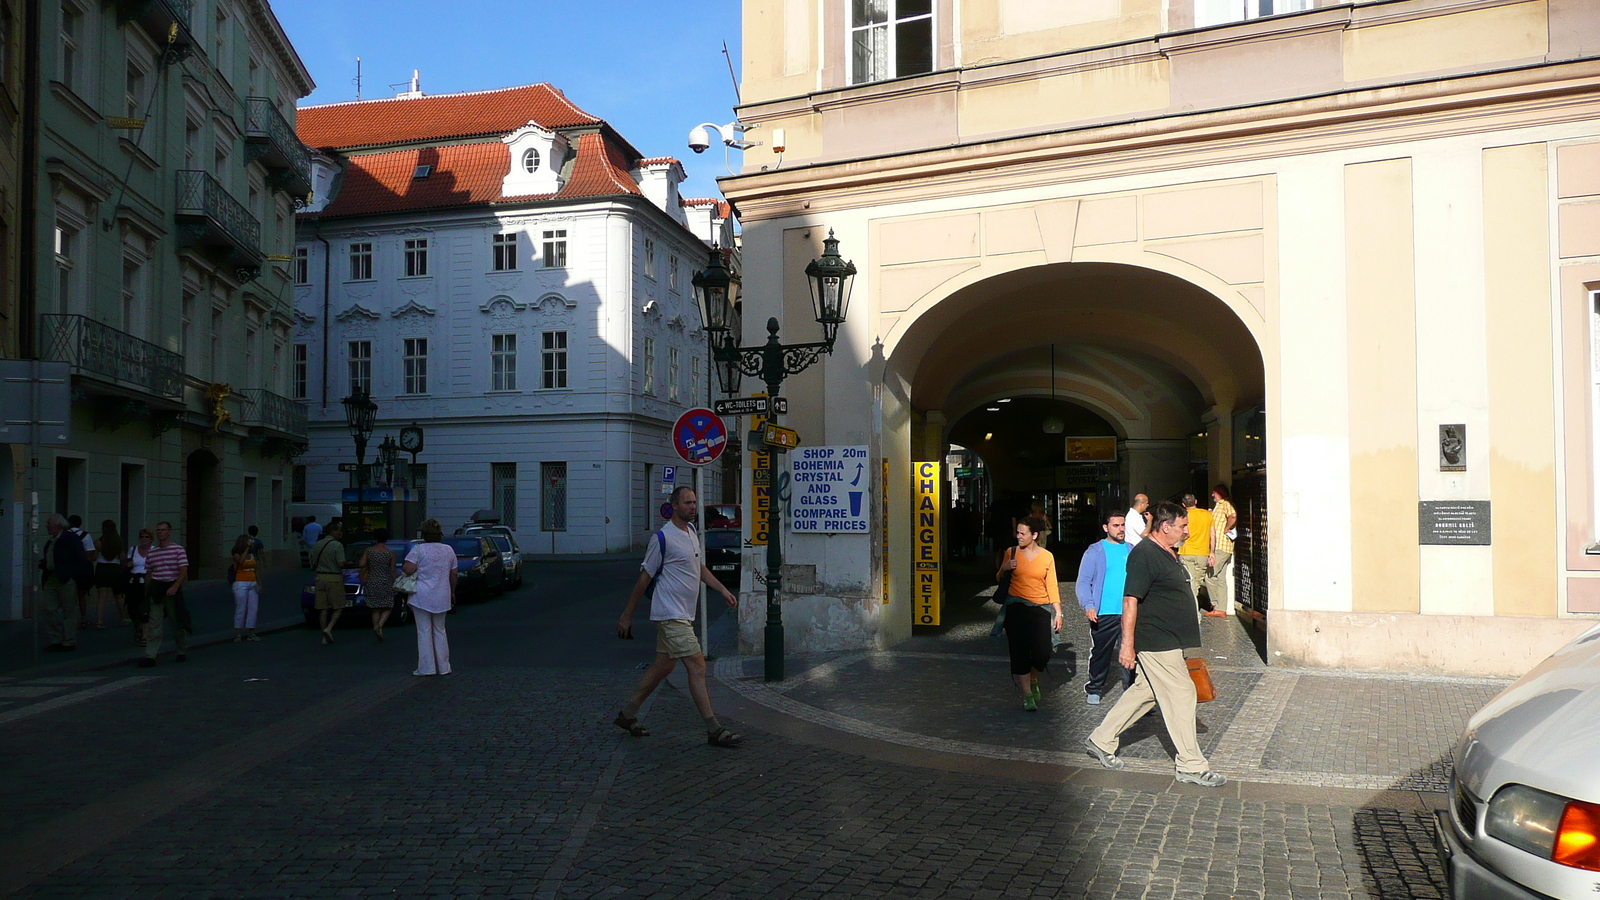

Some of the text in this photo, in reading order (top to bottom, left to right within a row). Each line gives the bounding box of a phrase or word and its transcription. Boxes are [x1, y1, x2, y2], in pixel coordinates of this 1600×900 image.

[724, 399, 756, 409] WC-TOILETS
[803, 448, 867, 459] SHOP 20m
[793, 460, 845, 471] BOHEMIA
[664, 467, 673, 478] P
[794, 472, 844, 482] CRYSTAL
[1067, 476, 1098, 484] CRYSTA
[807, 484, 831, 493] AND
[800, 495, 838, 505] GLASS
[756, 487, 770, 541] NETTO
[793, 508, 848, 519] COMPARE
[919, 463, 935, 560] CHANGE
[794, 520, 867, 530] OUR PRICES
[920, 574, 934, 624] NETTO
